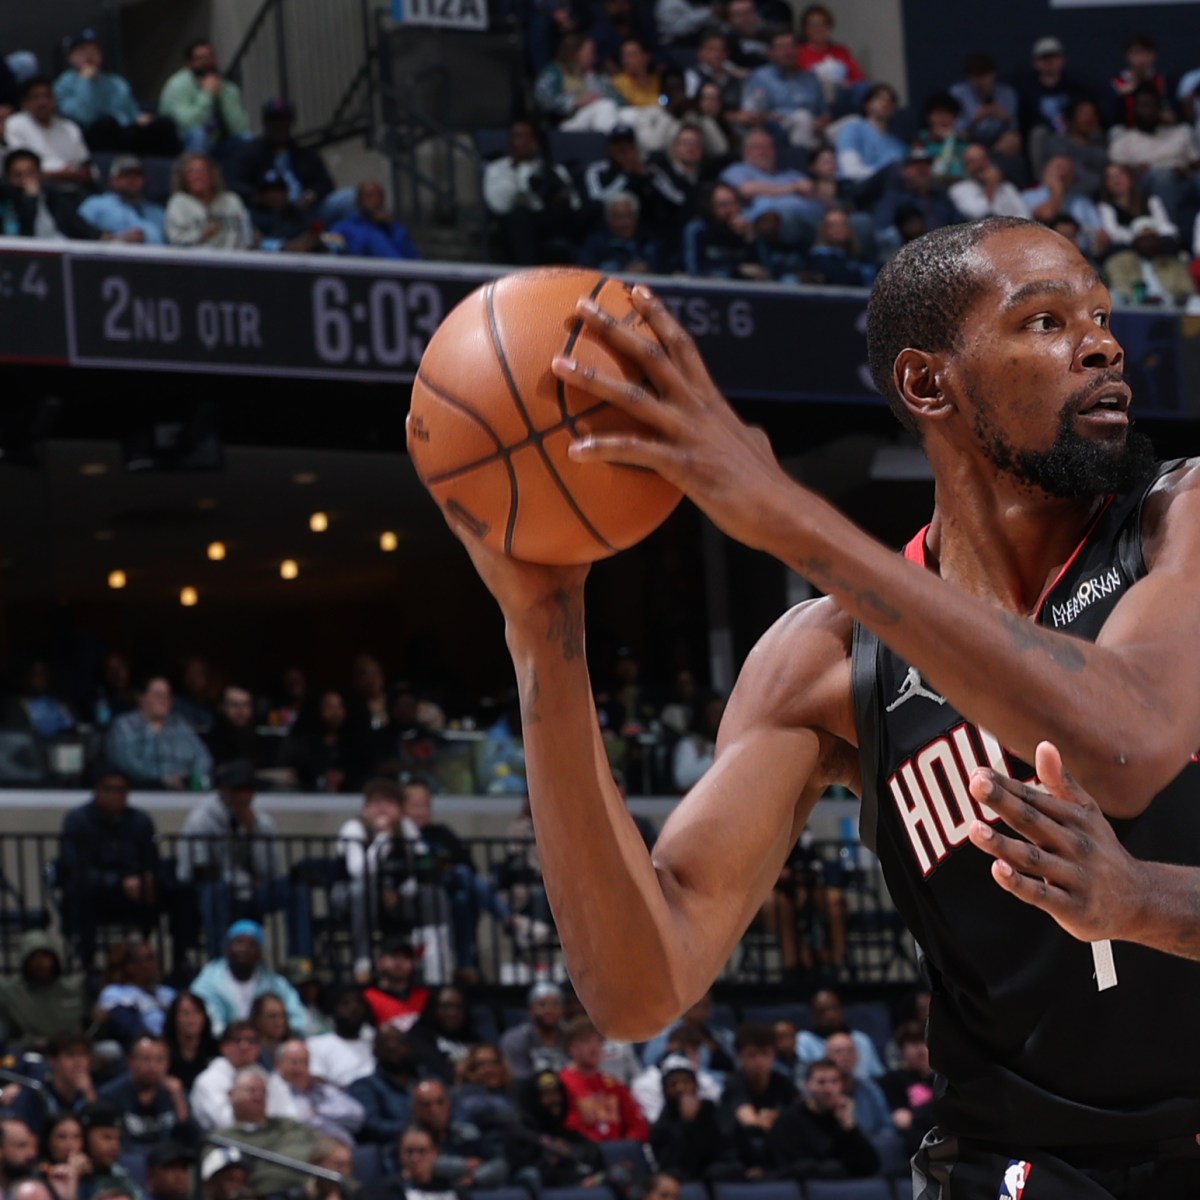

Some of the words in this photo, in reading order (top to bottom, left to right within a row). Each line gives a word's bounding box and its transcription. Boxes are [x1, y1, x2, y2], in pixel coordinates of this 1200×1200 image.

[103, 276, 181, 343] 2ND
[198, 302, 262, 348] QTR
[312, 278, 442, 366] 6:03
[727, 301, 754, 338] 6
[887, 722, 1050, 878] HOU
